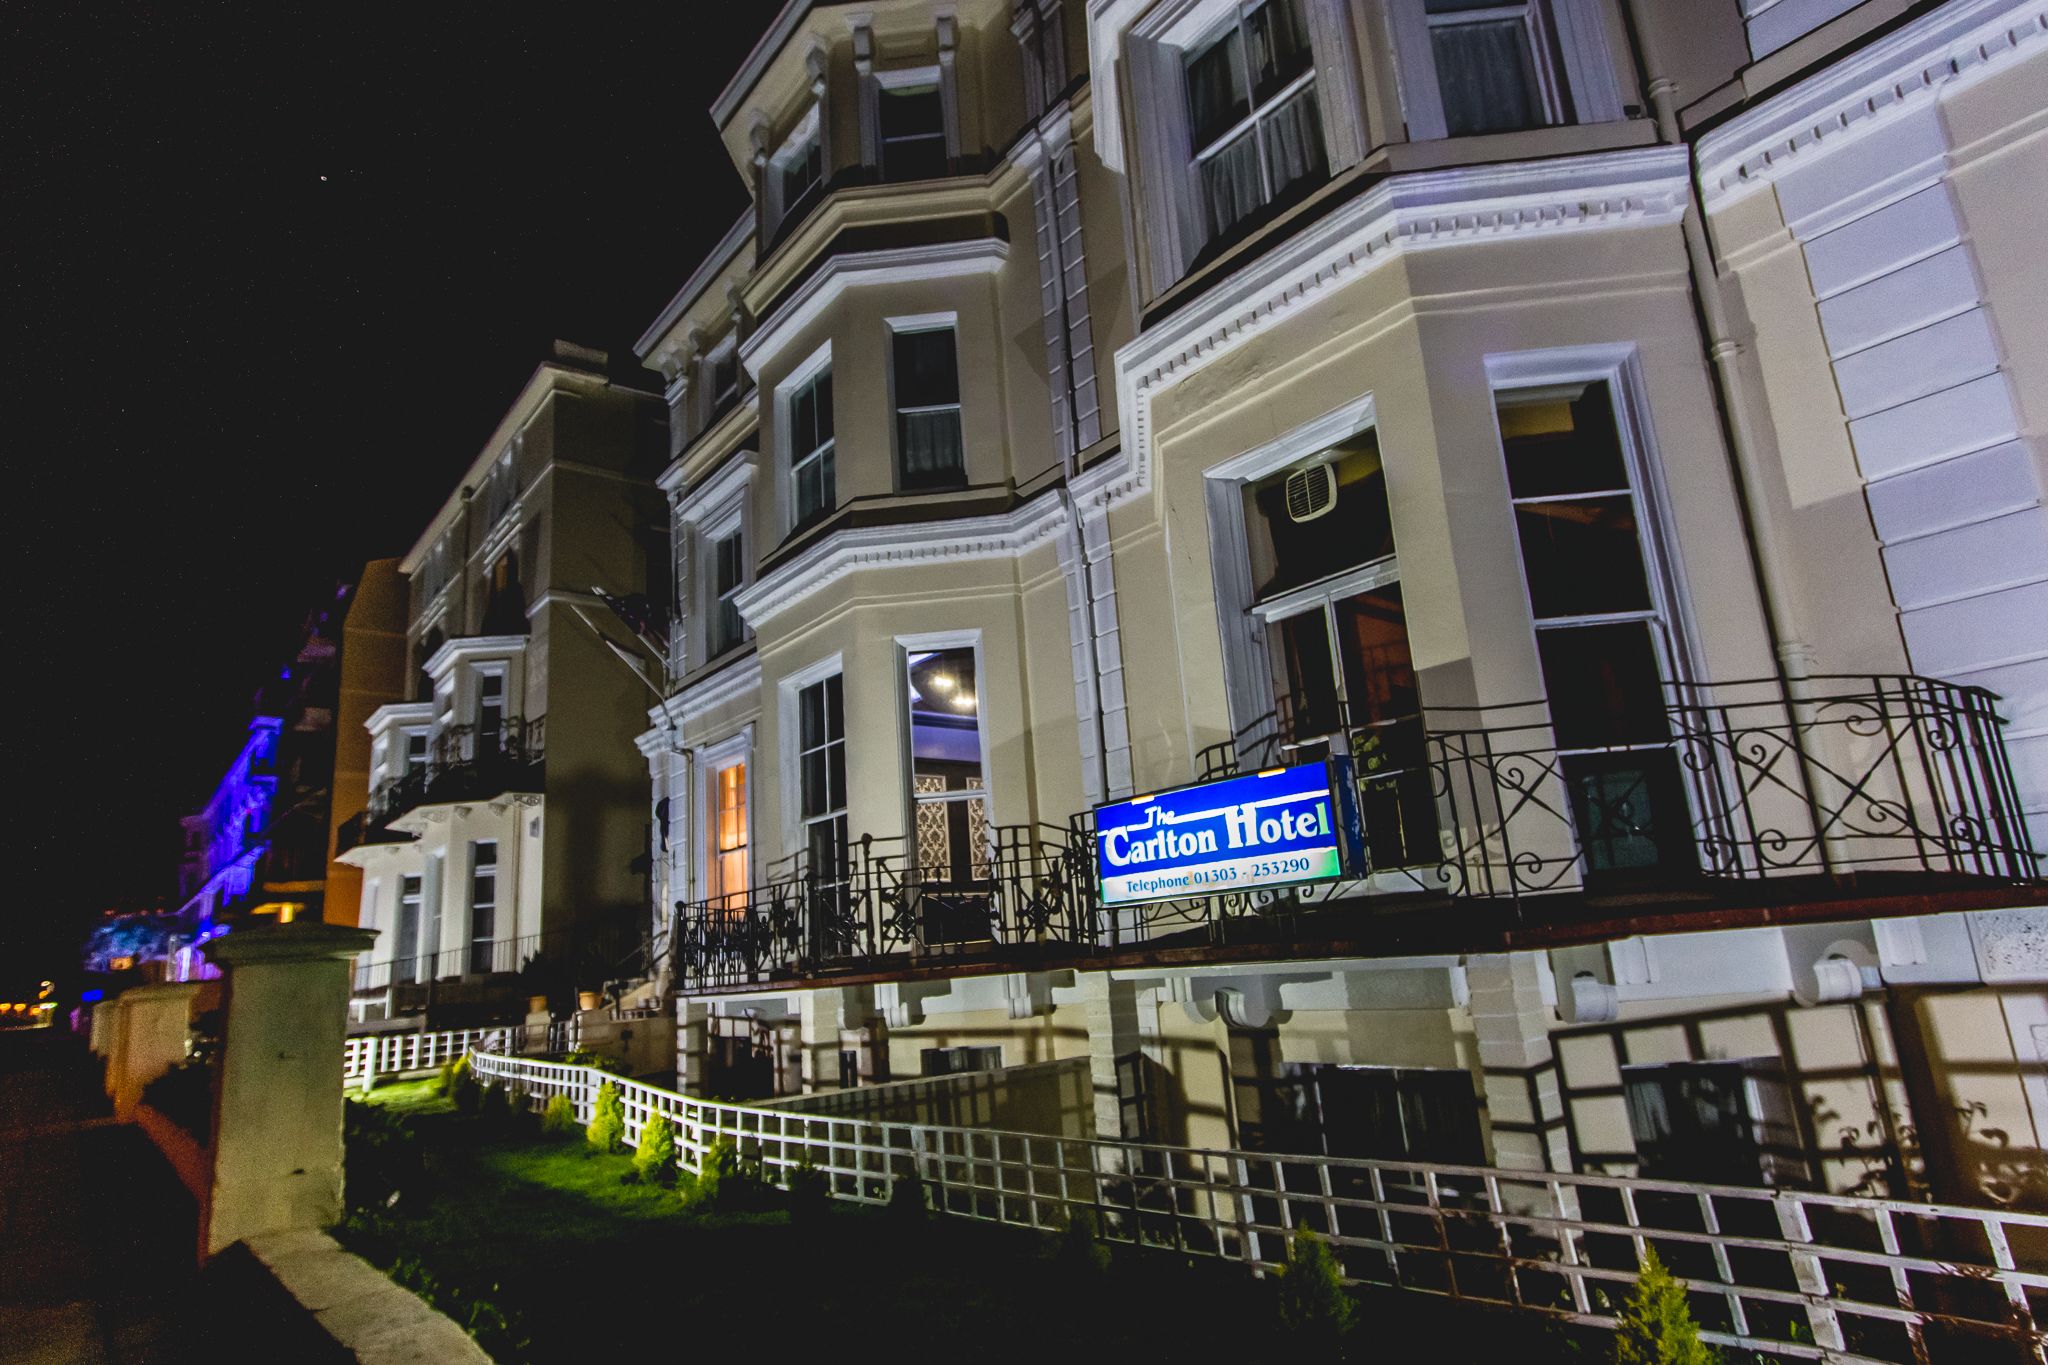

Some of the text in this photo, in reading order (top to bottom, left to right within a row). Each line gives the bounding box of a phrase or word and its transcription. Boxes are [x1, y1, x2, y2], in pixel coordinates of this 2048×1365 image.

[1104, 802, 1331, 867] Carlton Hotel
[1145, 806, 1175, 828] The
[1126, 875, 1189, 893] Telephone
[1194, 867, 1237, 884] 01303
[1251, 857, 1310, 877] 253290
